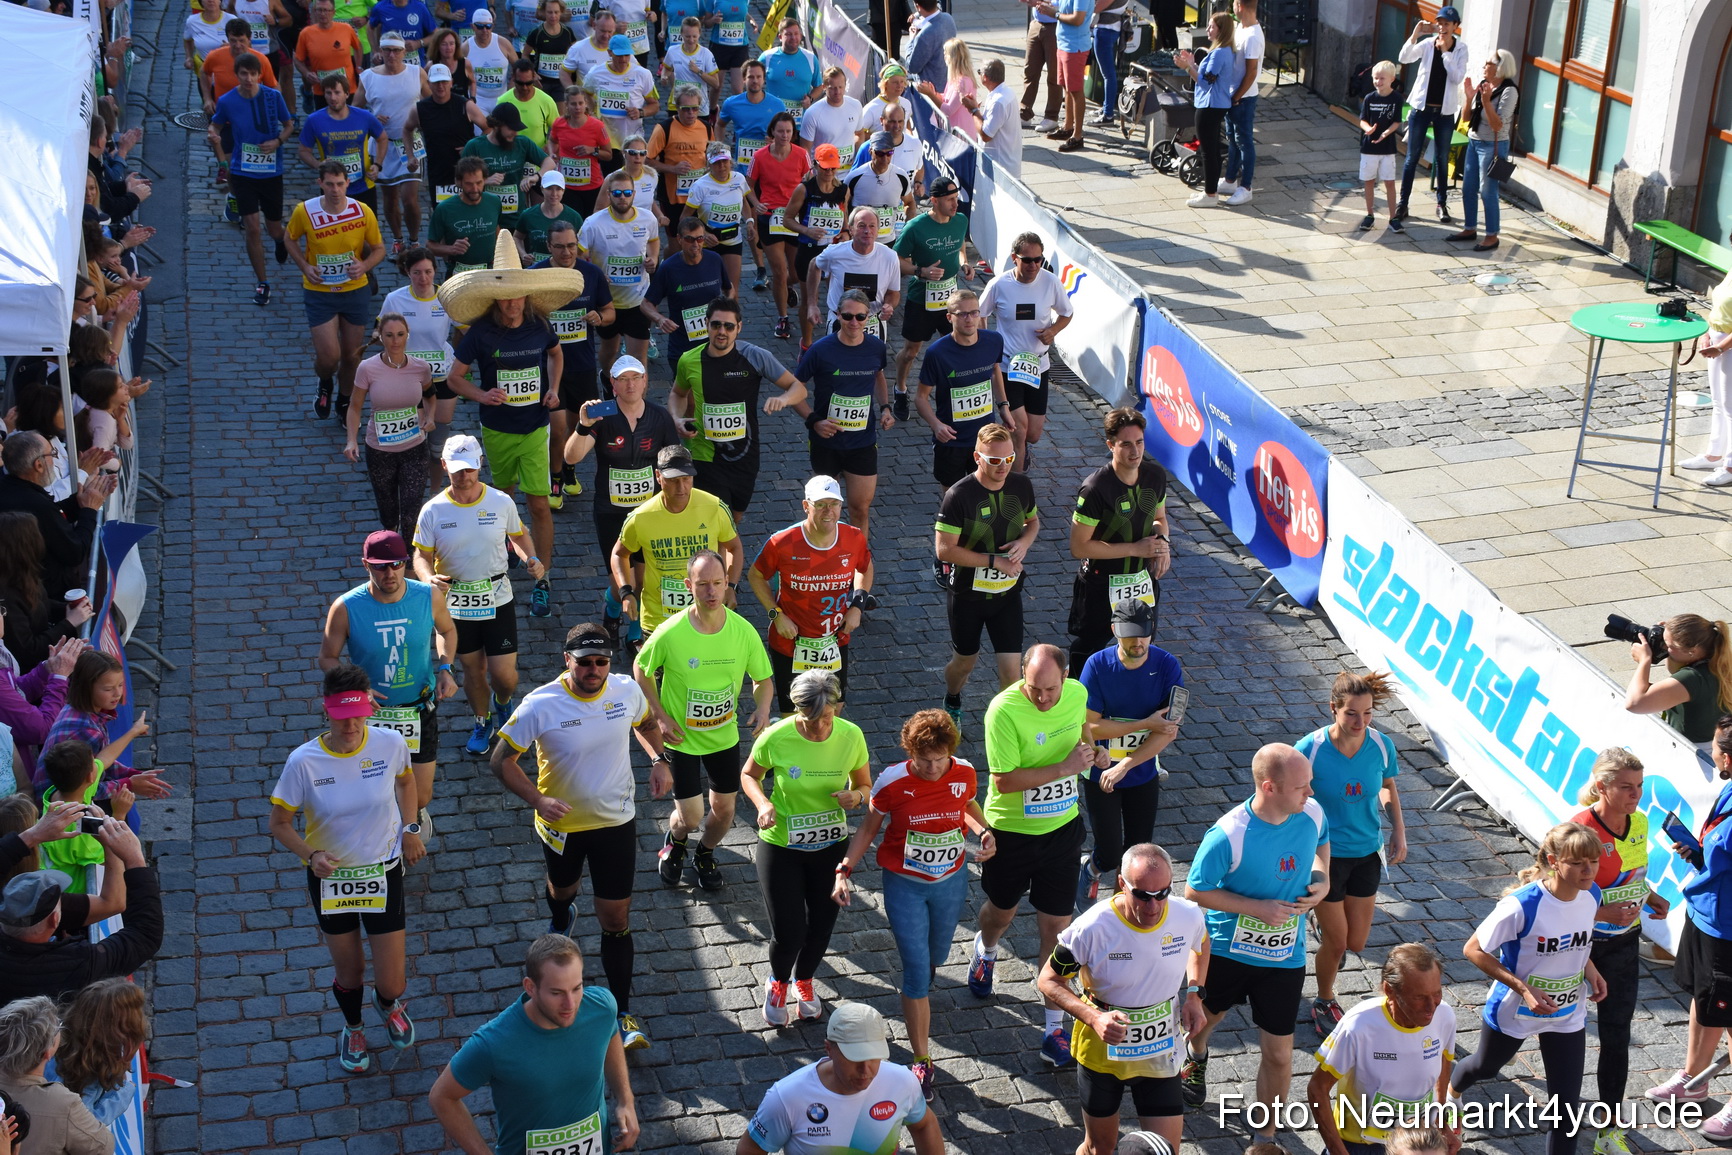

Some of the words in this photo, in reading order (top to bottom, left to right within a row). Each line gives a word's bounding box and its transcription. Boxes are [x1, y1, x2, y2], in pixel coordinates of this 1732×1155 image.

[627, 28, 644, 38] 2309
[722, 30, 741, 38] 2467
[478, 74, 500, 83] 2354
[601, 99, 626, 109] 2706
[246, 154, 273, 163] 2274
[563, 166, 587, 176] 1231
[712, 204, 740, 212] BOCK
[812, 209, 842, 217] BOCK
[712, 212, 737, 223] 2749
[813, 217, 839, 229] 2345
[315, 228, 339, 240] MAX
[342, 221, 367, 233] BÖGL
[319, 254, 352, 264] BOCK
[608, 256, 643, 264] BOCK
[611, 266, 639, 276] 2190
[552, 321, 582, 333] 1185
[500, 350, 518, 358] GOSSEN
[500, 368, 539, 380] BOCK
[1012, 362, 1039, 377] 2430
[503, 380, 536, 393] 1186
[954, 384, 990, 397] BOCK
[1145, 352, 1202, 432] Hervis
[833, 397, 868, 407] BOCK
[957, 394, 988, 410] 1187
[378, 408, 416, 421] BOCK
[705, 404, 742, 414] BOCK
[834, 407, 865, 419] 1184
[962, 407, 985, 418] OLIVER
[381, 418, 415, 434] 2246
[707, 416, 742, 428] 1109
[386, 431, 414, 442] LARISSA
[613, 471, 650, 480] BOCK
[1215, 455, 1237, 484] MOBILE
[615, 481, 649, 494] 1339
[617, 495, 646, 503] MARKUS
[1259, 447, 1319, 543] Hervis
[651, 537, 672, 549] BMW
[674, 534, 709, 547] BERLIN
[653, 544, 709, 558] MARATHON
[790, 571, 852, 582] MediaMarktSaturn
[1113, 571, 1146, 586] BOCK
[790, 579, 852, 592] RUNNERS
[1115, 583, 1148, 600] 1350
[451, 594, 490, 607] 2355
[820, 593, 848, 616] 20
[450, 608, 491, 617] CHRISTIAN
[820, 612, 844, 636] 19
[800, 647, 835, 663] 1342
[340, 695, 361, 704] 2XU
[692, 689, 733, 702] BOCK
[693, 700, 730, 719] 5059
[560, 719, 582, 728] BOCK
[696, 716, 727, 727] HOLGER
[373, 723, 414, 738] 153
[1030, 780, 1073, 802] 2233
[1030, 798, 1075, 813] CHRISTIAN
[792, 812, 838, 828] BOCK
[796, 827, 842, 846] 2238
[910, 833, 960, 846] BOCK
[911, 848, 958, 864] 2070
[915, 861, 951, 874] MARION
[329, 881, 380, 896] 1059
[1607, 884, 1645, 899] BOCK
[335, 899, 374, 908] JANETT
[1162, 935, 1172, 945] 20
[1241, 931, 1291, 947] 2466
[1161, 941, 1186, 951] Neumarkter
[1238, 943, 1289, 957] RAINHARD
[1533, 975, 1582, 990] BOCK
[1114, 1040, 1169, 1055] WOLFGANG
[873, 1106, 895, 1118] Hervis
[532, 1119, 597, 1147] BOCK
